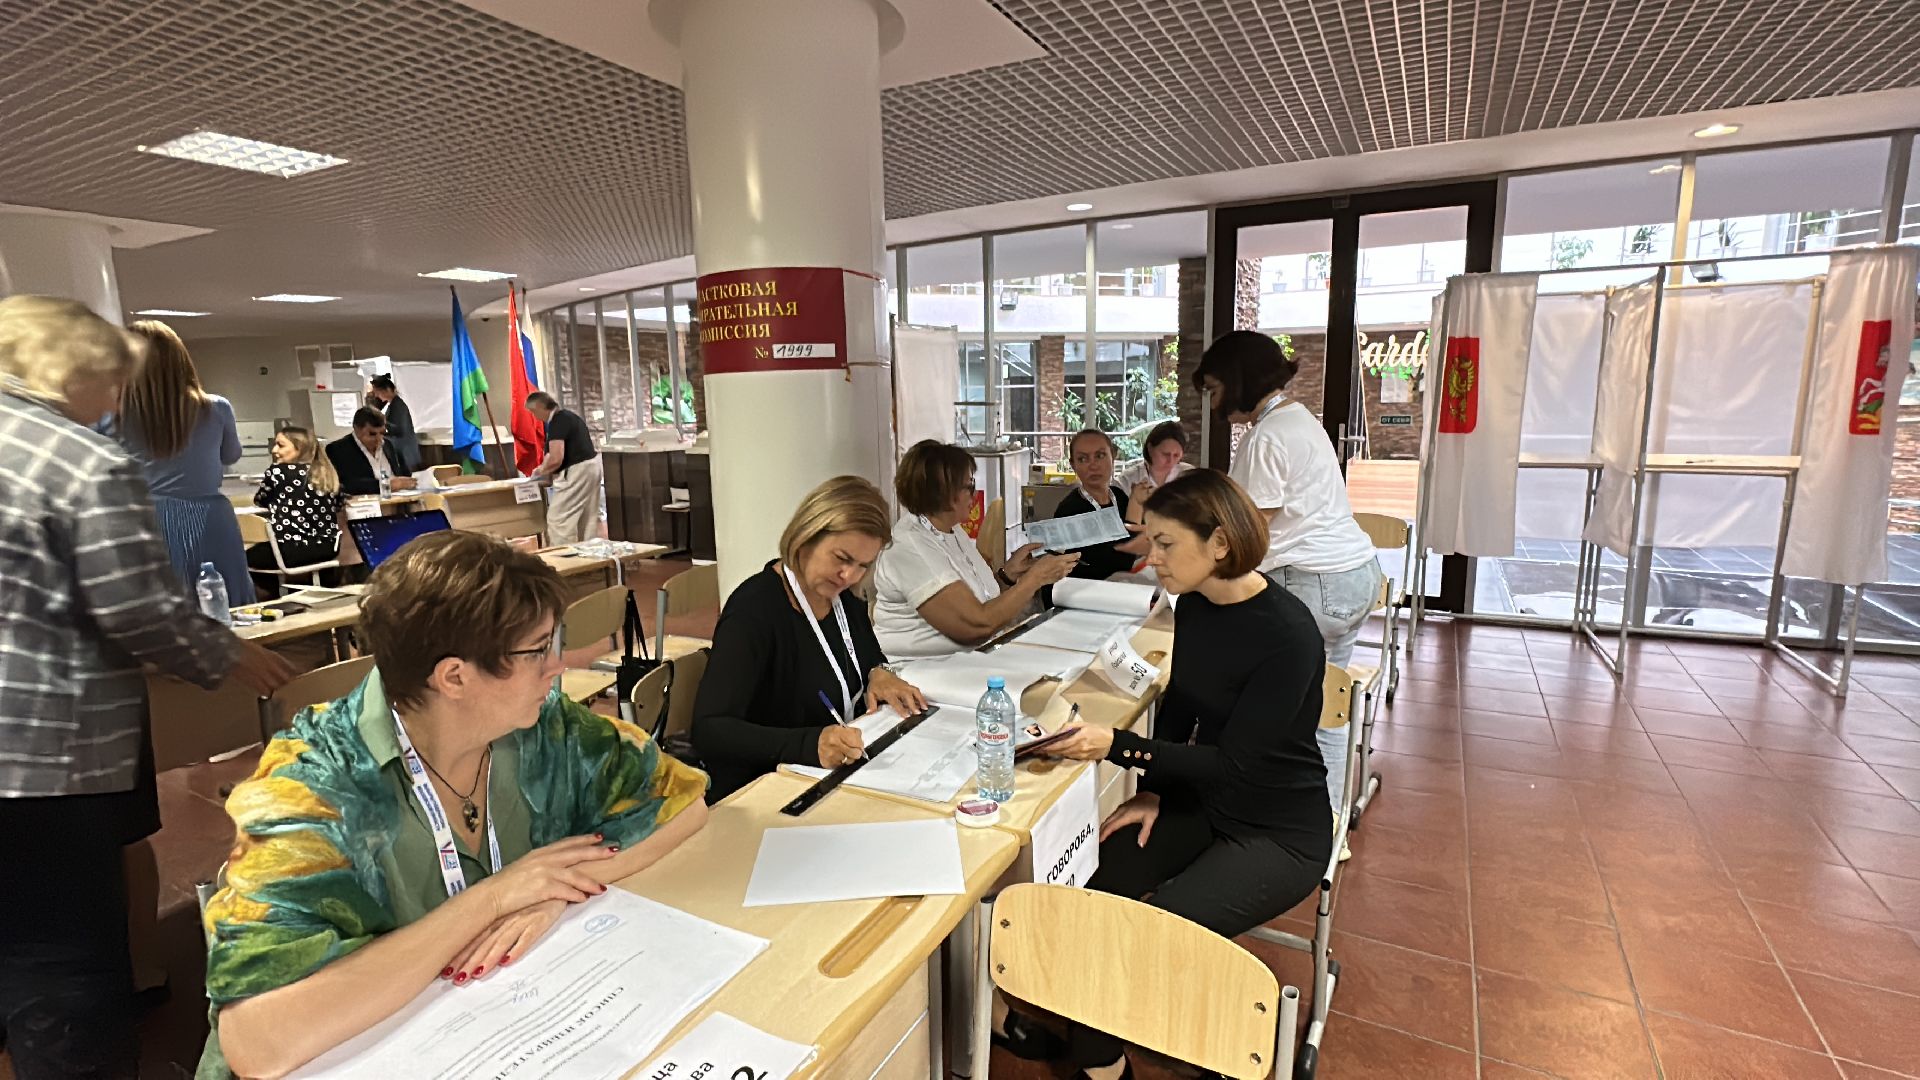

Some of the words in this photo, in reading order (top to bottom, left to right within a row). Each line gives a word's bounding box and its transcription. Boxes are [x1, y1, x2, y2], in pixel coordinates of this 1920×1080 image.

[755, 346, 769, 359] №
[776, 345, 813, 357] 1999
[1131, 662, 1148, 677] 50
[1046, 823, 1095, 884] ГОВОРОВА,
